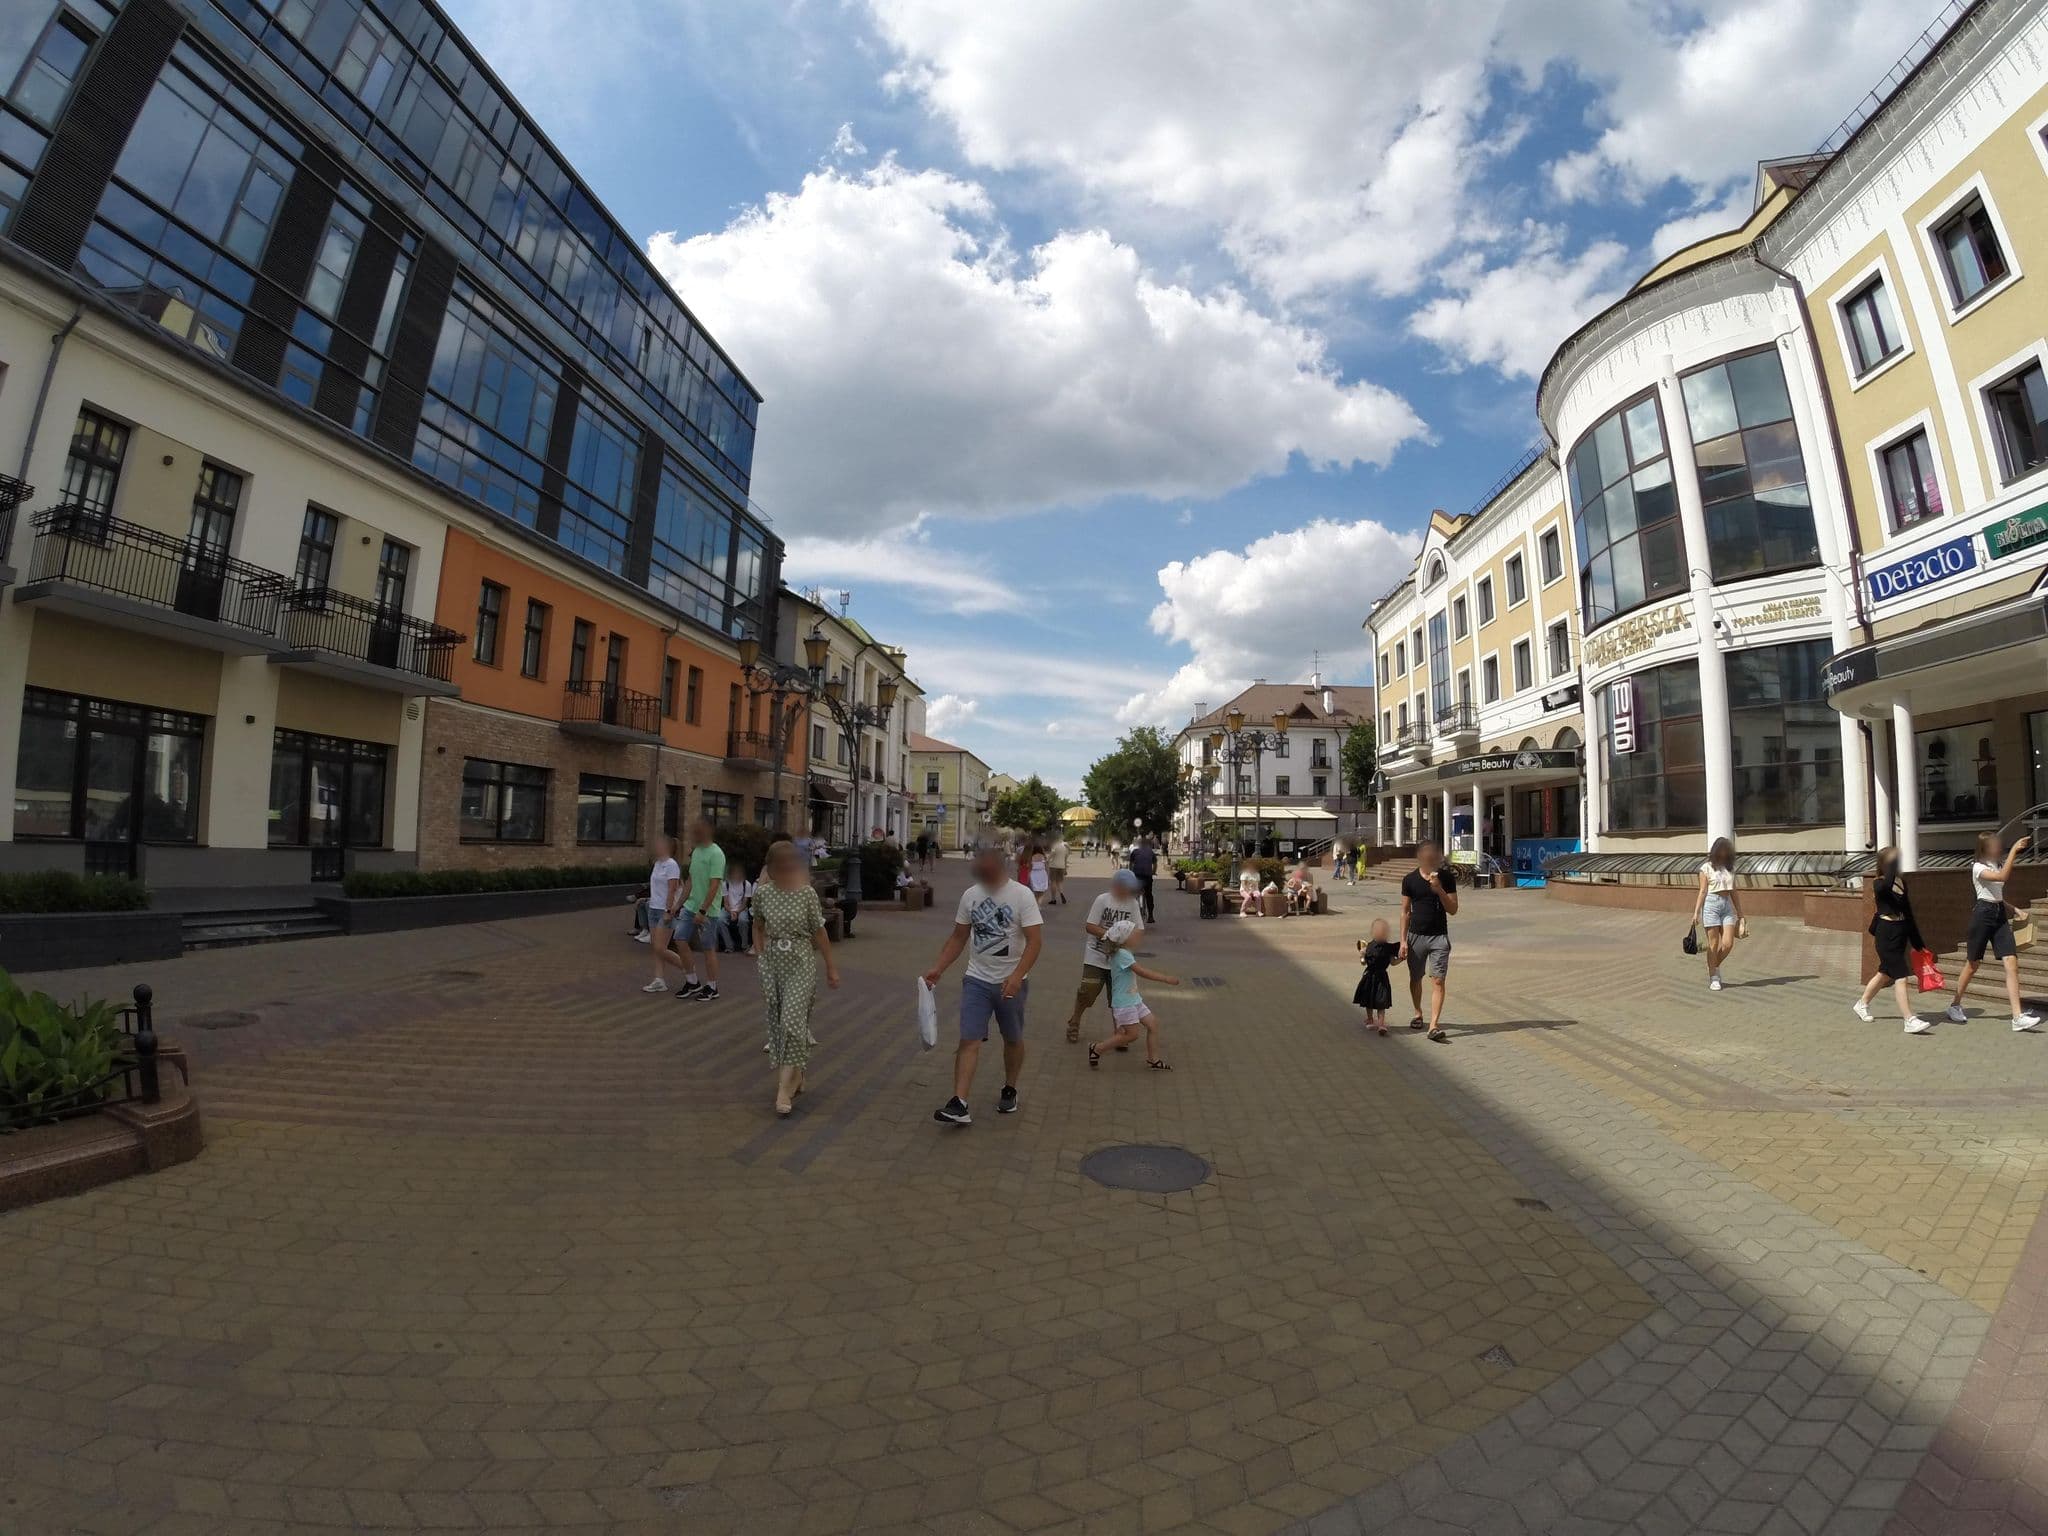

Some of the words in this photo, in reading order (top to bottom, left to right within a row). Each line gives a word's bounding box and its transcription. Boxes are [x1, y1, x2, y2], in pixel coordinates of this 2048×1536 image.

[1875, 547, 1963, 597] DeFacto
[1481, 758, 1511, 770] Beauty
[1102, 907, 1131, 921] SKATE
